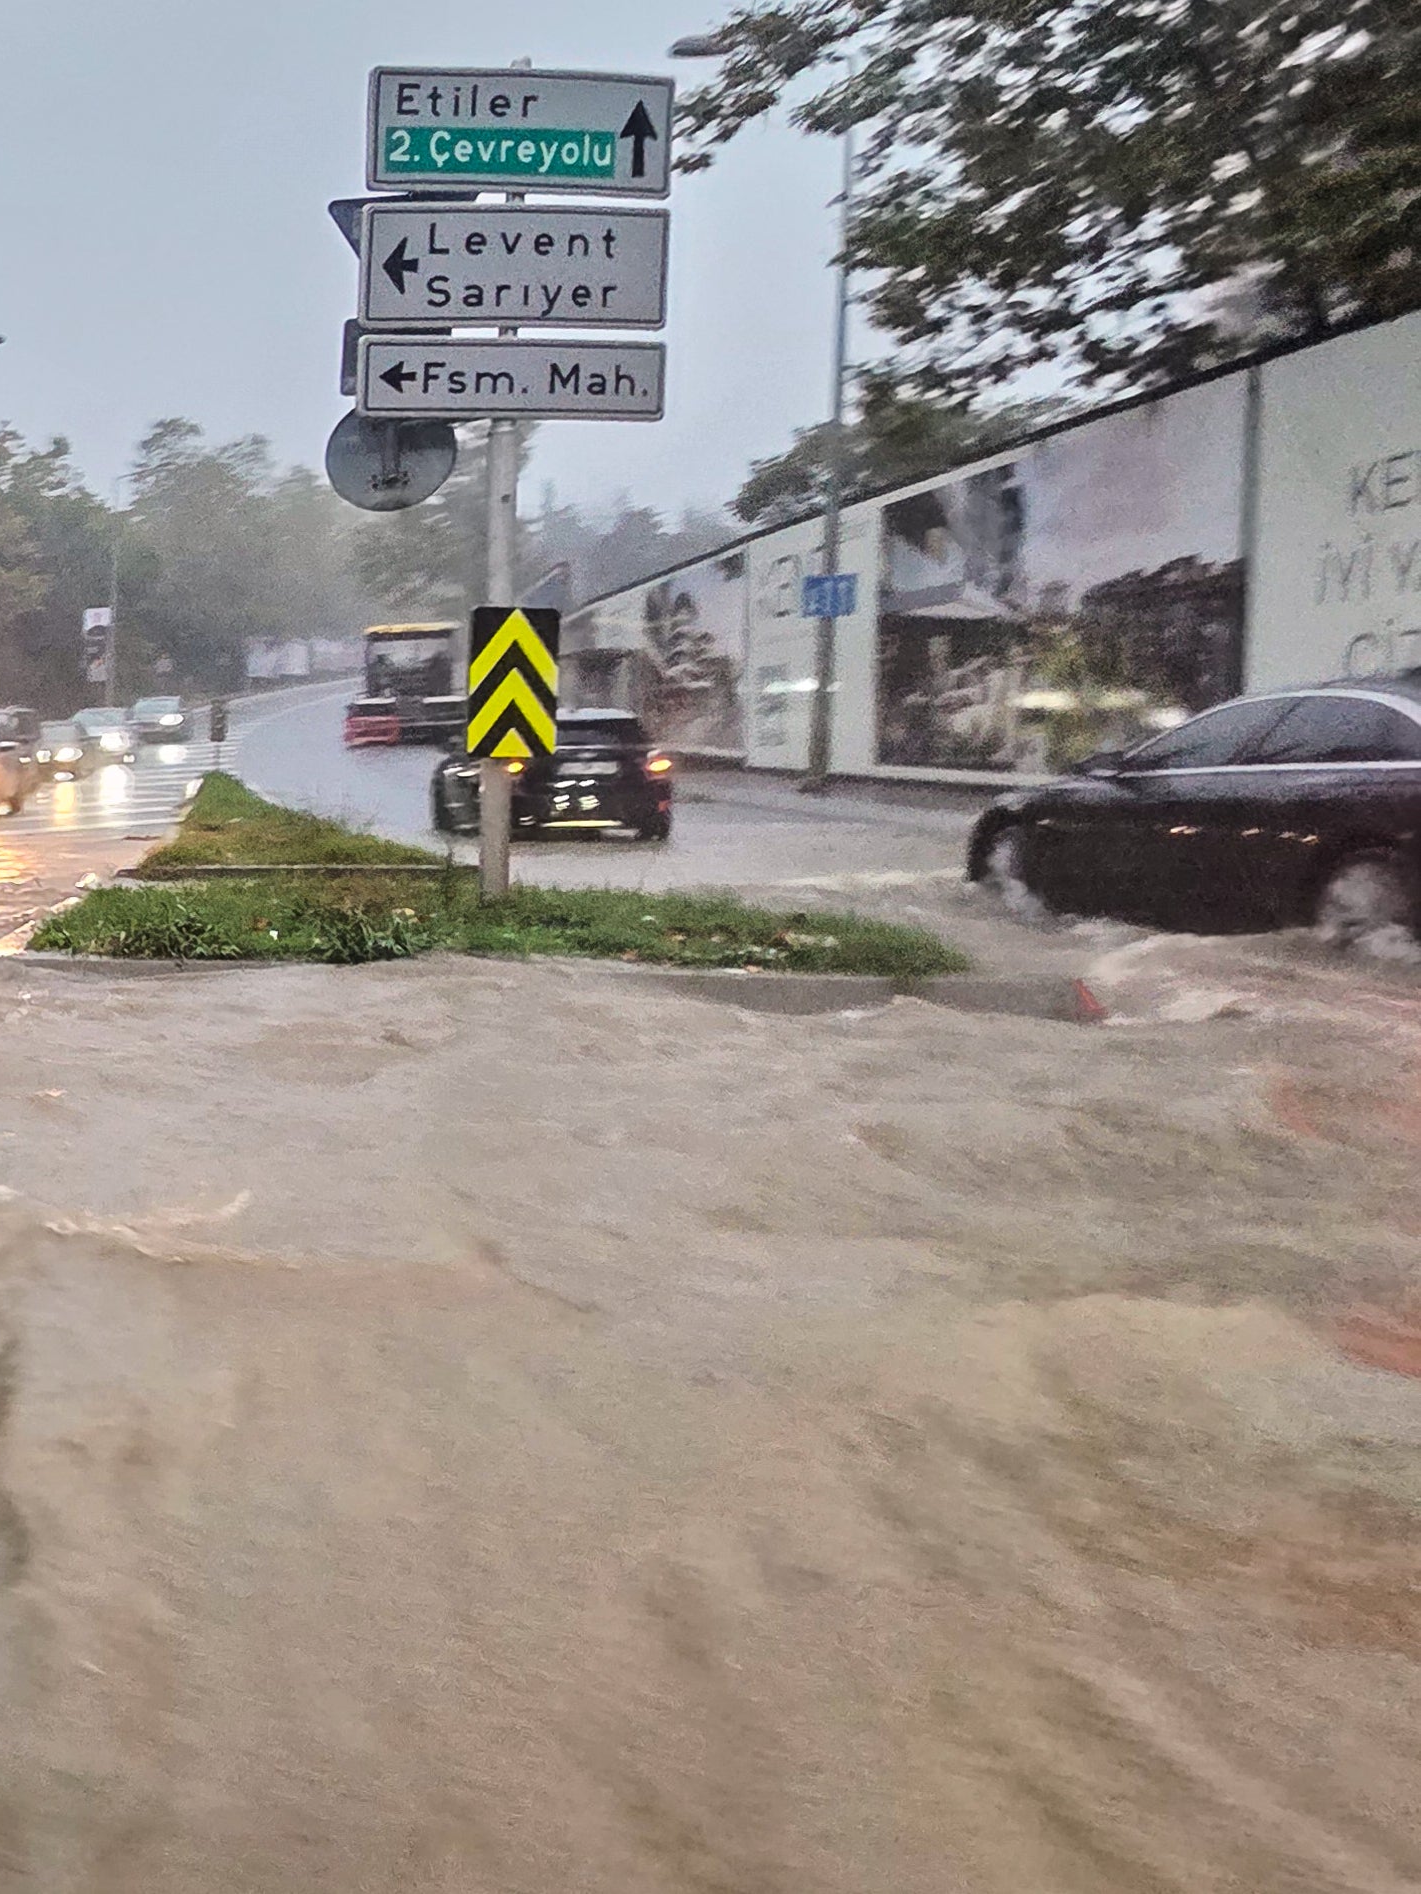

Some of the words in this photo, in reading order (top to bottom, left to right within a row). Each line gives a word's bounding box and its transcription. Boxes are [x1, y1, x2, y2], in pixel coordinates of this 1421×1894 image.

[396, 83, 539, 118] Etiler
[388, 130, 421, 163] 2.
[429, 130, 612, 173] Çevreyolu
[428, 222, 617, 259] Levent
[426, 275, 618, 317] Sarıyer
[422, 361, 529, 395] Fsm.
[548, 362, 649, 397] Mah.
